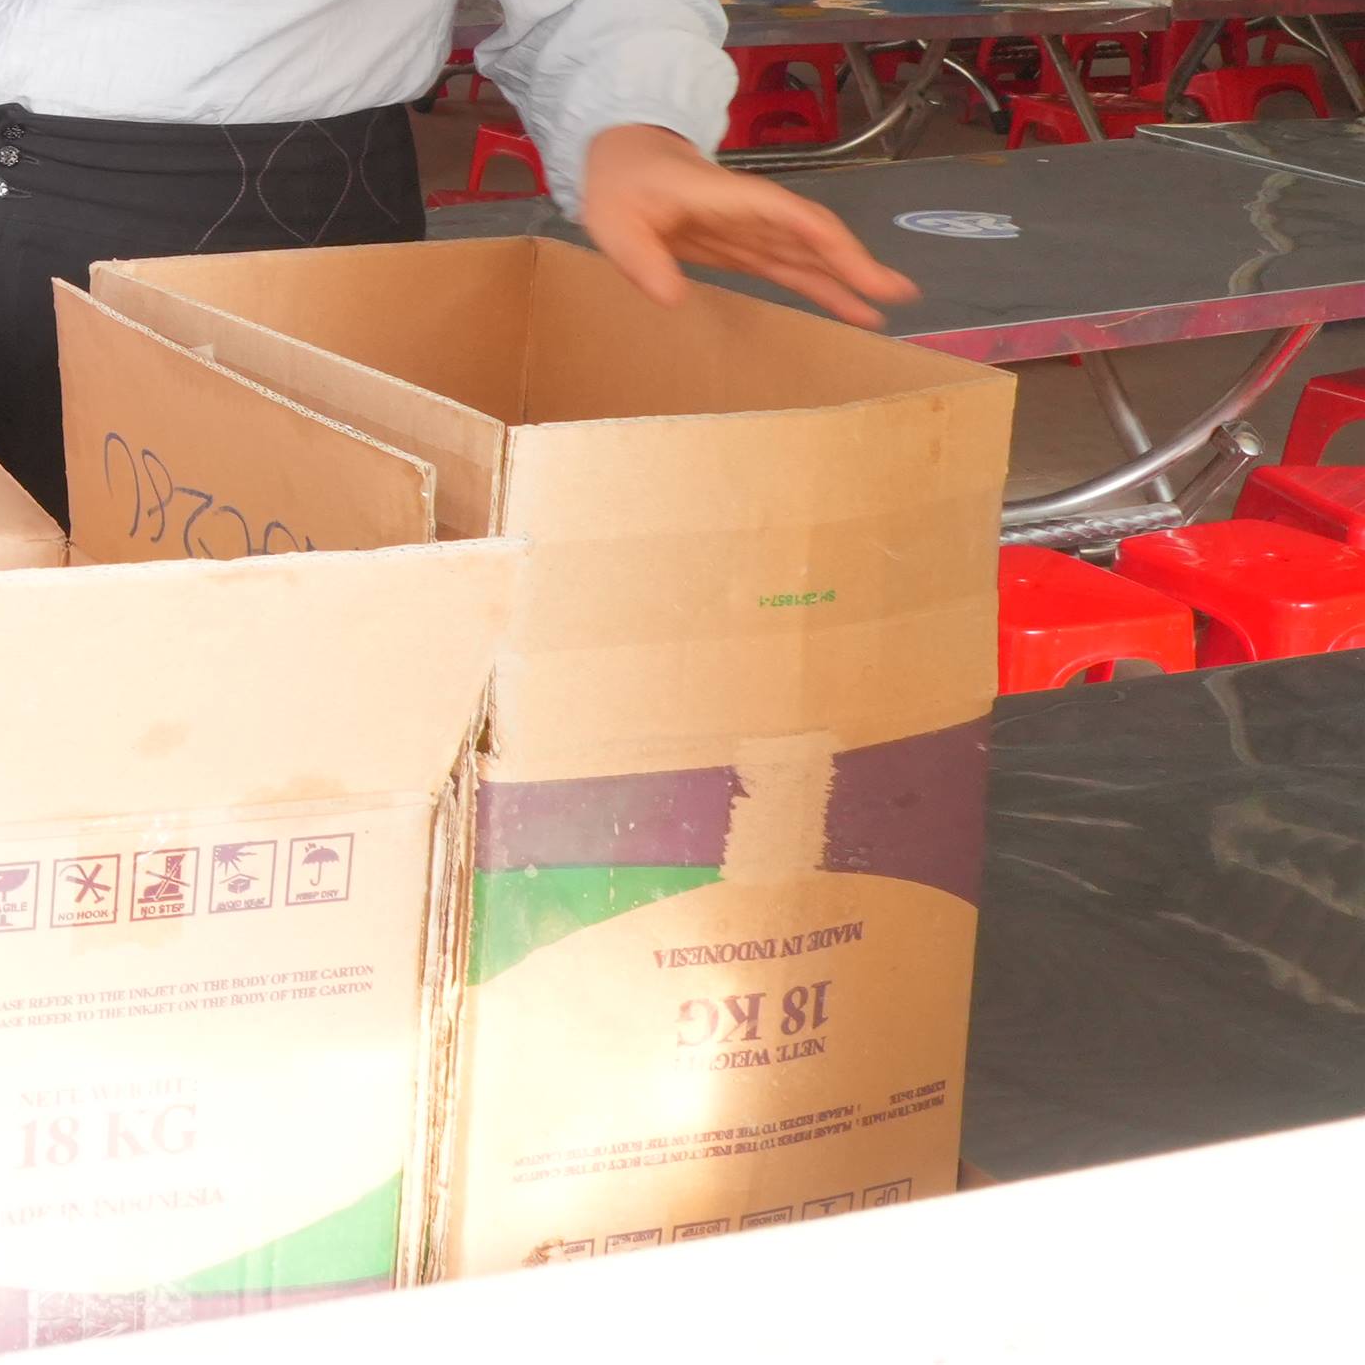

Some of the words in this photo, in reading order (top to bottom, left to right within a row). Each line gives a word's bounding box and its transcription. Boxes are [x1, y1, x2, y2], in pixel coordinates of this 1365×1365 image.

[58, 912, 75, 923] NO
[77, 908, 109, 920] HOOK
[140, 904, 157, 916] NO
[159, 902, 185, 914] STEP
[807, 921, 865, 951] MADE
[652, 938, 776, 970] INDONESIA
[779, 935, 806, 959] IN
[29, 993, 73, 1010] REFER
[77, 991, 97, 1006] TO
[99, 988, 125, 1003] THE
[129, 983, 177, 1000] INKJET
[179, 980, 199, 995] ON
[202, 977, 229, 993] THE
[232, 973, 269, 990] BODY
[271, 971, 288, 986] OF
[290, 968, 317, 984] THE
[320, 963, 375, 981] CARTON
[28, 1010, 72, 1027] REFER
[76, 1008, 96, 1023] TO
[98, 1005, 124, 1021] THE
[178, 998, 197, 1013] ON
[202, 994, 228, 1010] THE
[230, 990, 268, 1007] BODY
[270, 988, 286, 1003] OF
[289, 985, 315, 1001] THE
[319, 979, 374, 998] CARTON
[780, 979, 833, 1036] 18
[674, 992, 767, 1048] KG
[735, 1123, 758, 1137] THE
[761, 1119, 777, 1131] TO
[14, 1115, 83, 1170] 18
[101, 1103, 197, 1161] KG
[671, 1134, 688, 1145] ON
[760, 1136, 775, 1148] TO
[607, 1139, 641, 1153] BODY
[735, 1139, 757, 1153] THE
[607, 1155, 640, 1169] BODY
[670, 1149, 687, 1161] ON
[874, 1187, 898, 1206] UP
[772, 1212, 787, 1223] NO
[681, 1226, 706, 1239] STEP
[707, 1223, 721, 1233] NO
